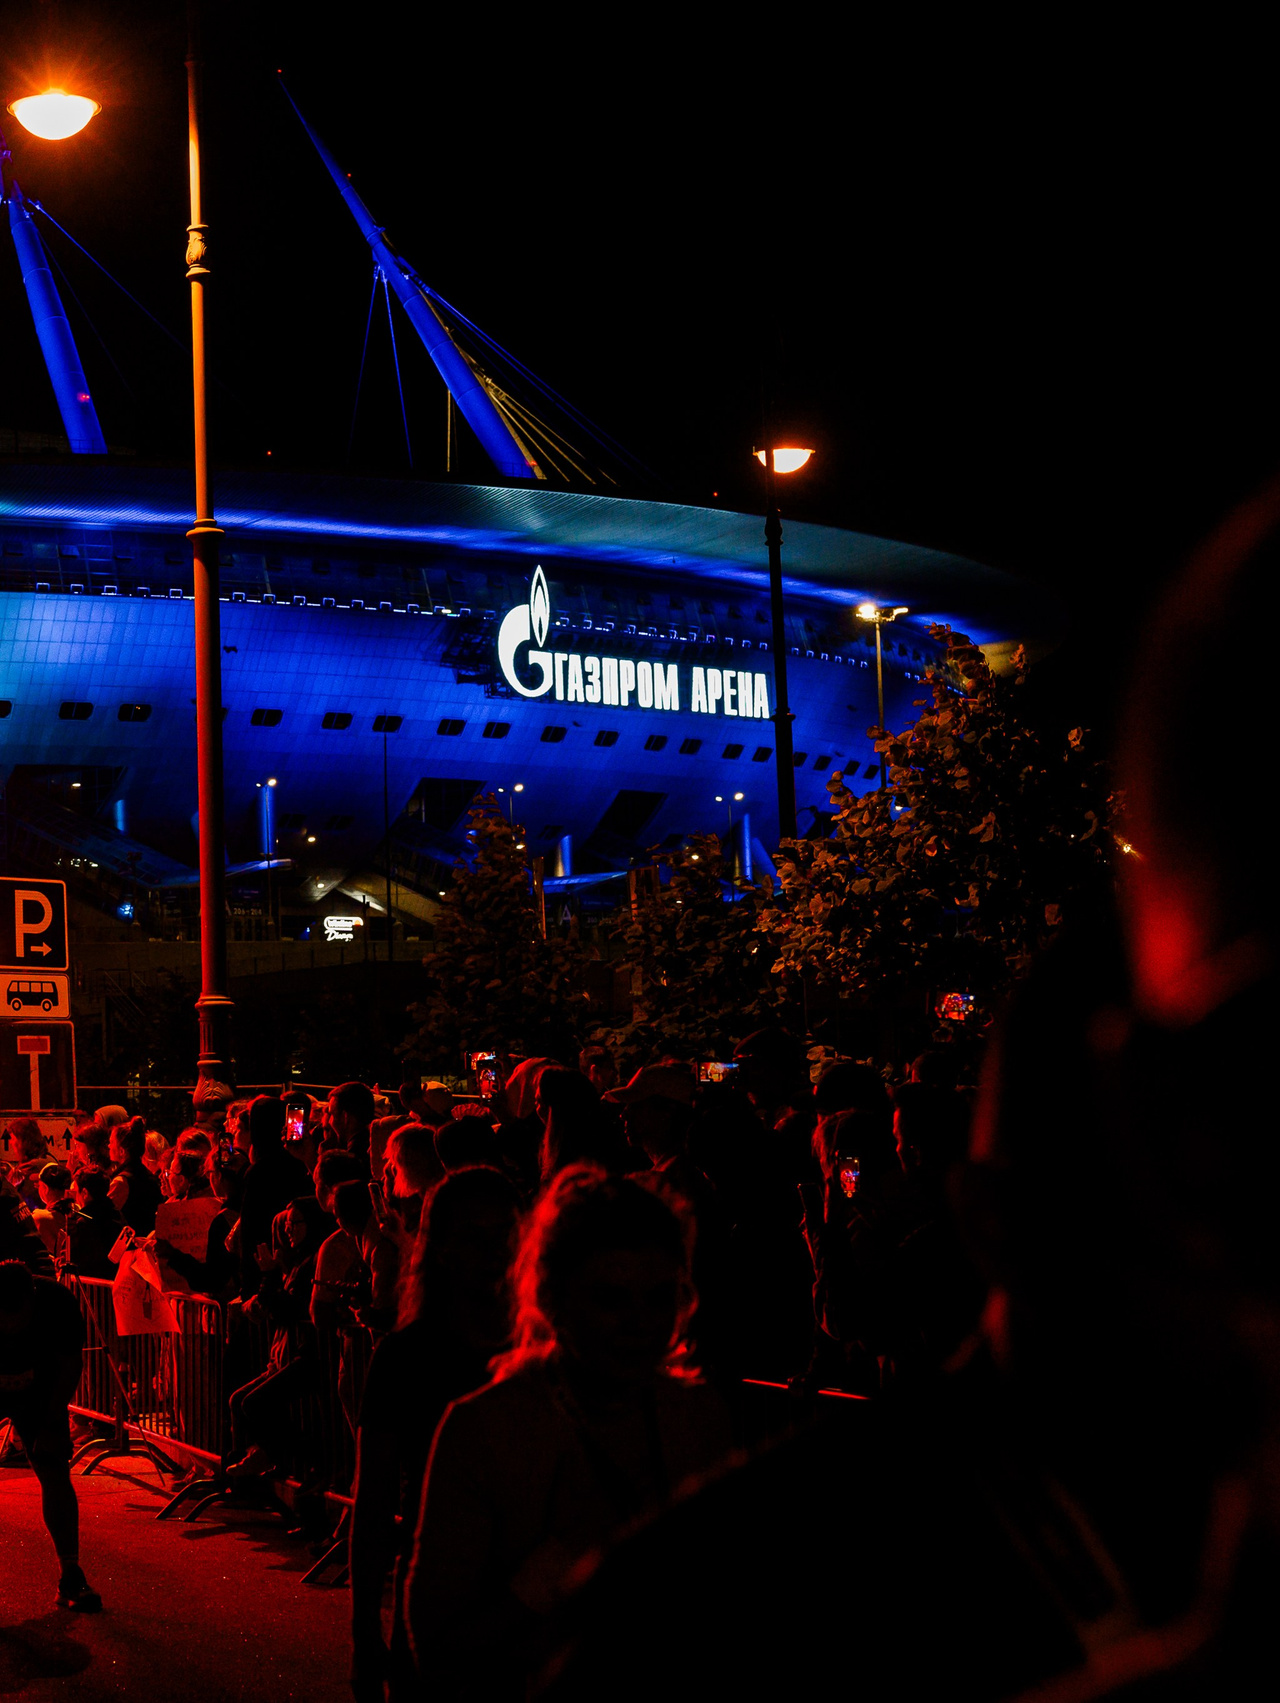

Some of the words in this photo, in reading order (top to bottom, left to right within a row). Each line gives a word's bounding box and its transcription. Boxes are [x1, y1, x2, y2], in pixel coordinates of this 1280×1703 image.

[554, 653, 679, 711] ГАЗПРОМ
[691, 667, 770, 719] АРЕНА
[14, 889, 53, 958] P
